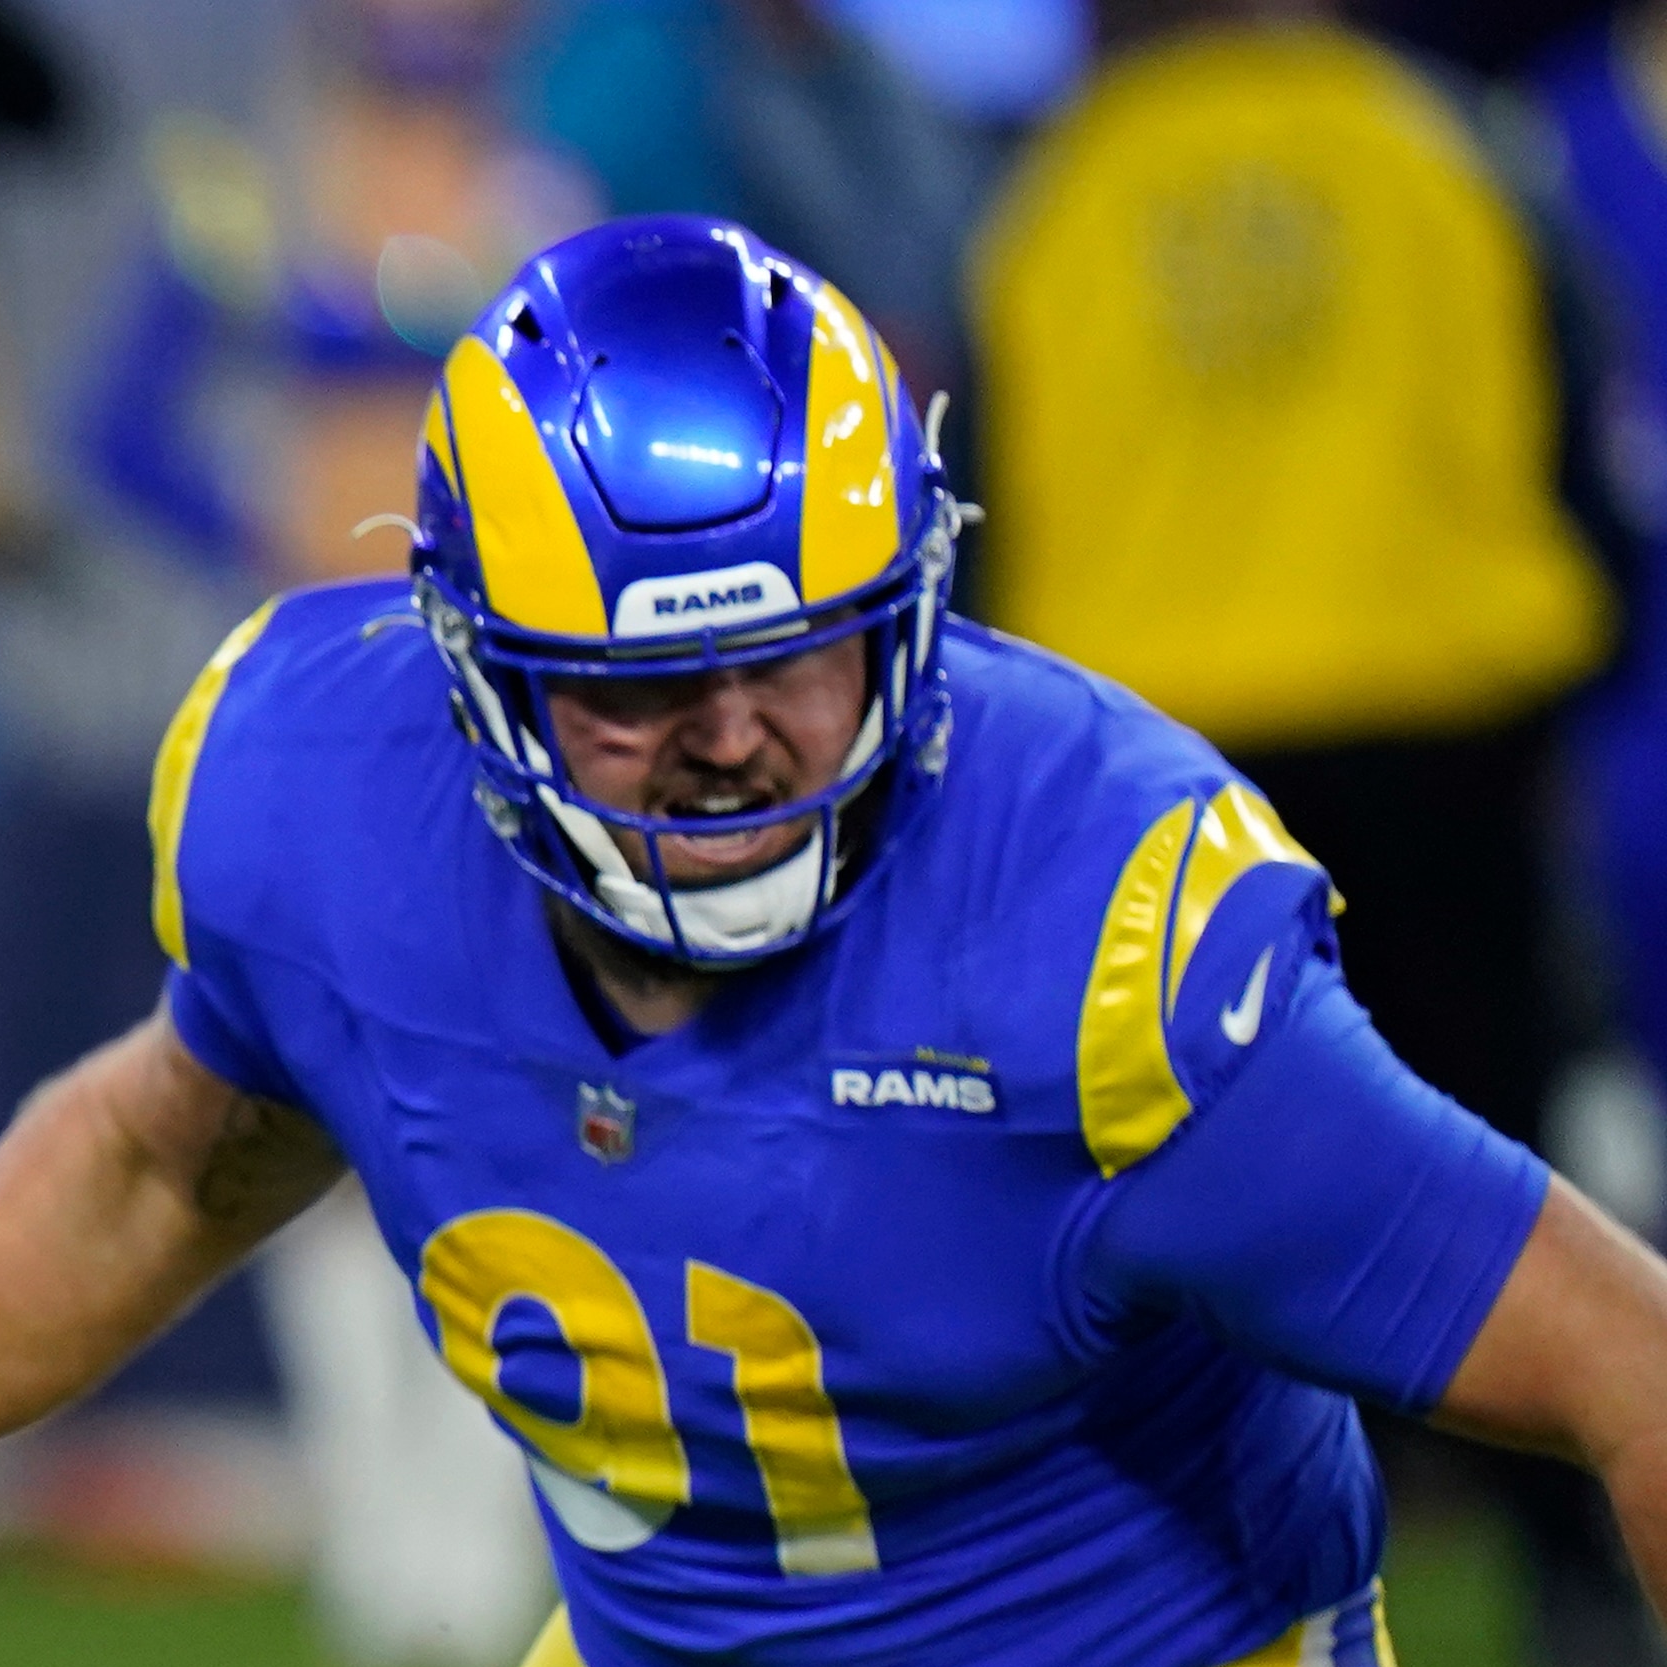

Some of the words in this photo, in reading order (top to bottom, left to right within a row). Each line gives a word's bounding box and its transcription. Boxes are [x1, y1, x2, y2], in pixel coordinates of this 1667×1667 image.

[654, 583, 764, 616] RAMS
[831, 1068, 997, 1114] RAMS
[419, 1207, 880, 1576] 91
